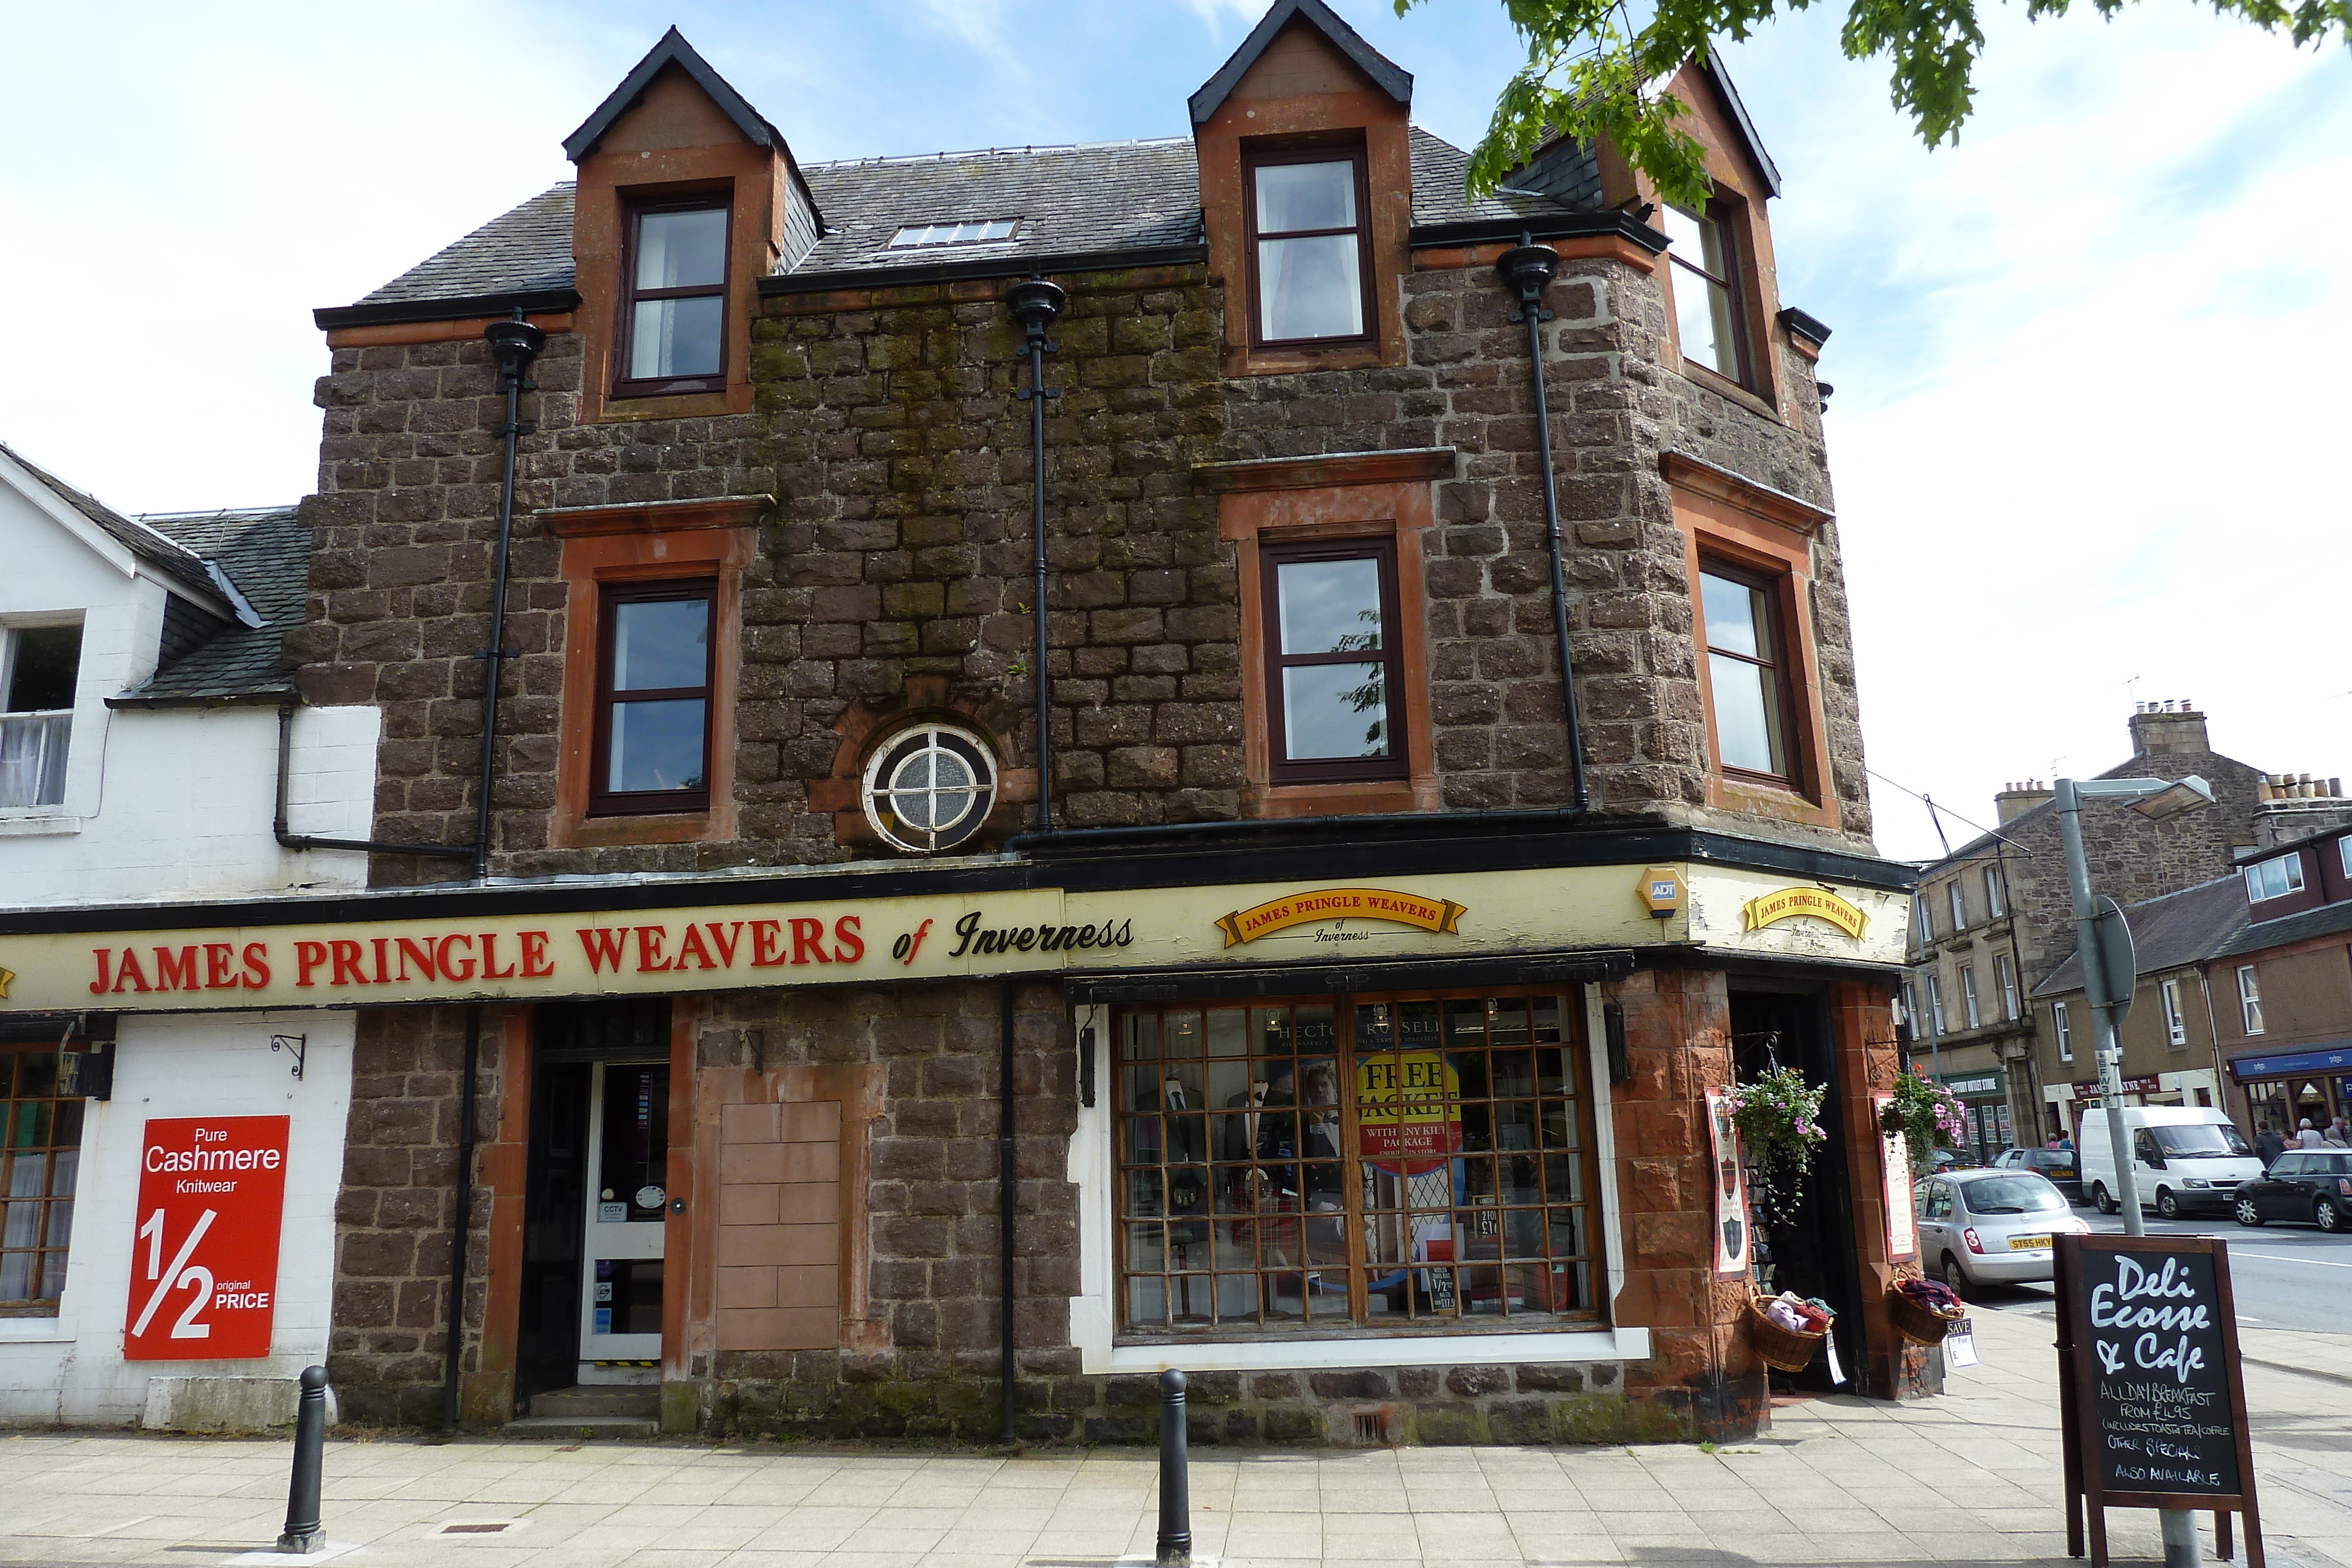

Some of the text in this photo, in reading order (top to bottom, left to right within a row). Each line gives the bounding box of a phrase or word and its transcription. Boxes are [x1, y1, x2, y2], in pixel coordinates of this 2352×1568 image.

[1652, 884, 1675, 895] ADT
[1245, 896, 1436, 931] JAMES PRINGLE WEAVERS
[1760, 895, 1858, 928] JAMES PRINGLE WEAVERS
[1335, 918, 1346, 931] of
[1314, 928, 1370, 942] Inverness
[90, 911, 1134, 995] JAMES PRINGLE WEAVERS of Inverness
[195, 1128, 227, 1142] Pure
[1367, 1127, 1396, 1137] WITH
[146, 1145, 280, 1173] Cashmere
[176, 1179, 238, 1193] Knitwear
[2013, 1238, 2051, 1248] ST55 HKY
[131, 1208, 218, 1339] 1/2
[2114, 1255, 2195, 1300] Deli
[216, 1280, 250, 1291] original
[1432, 1279, 1447, 1292] 1/2
[215, 1293, 269, 1309] PRICE
[2091, 1283, 2210, 1331] Ecosse
[1949, 1321, 1970, 1335] SAVE
[2097, 1332, 2204, 1383] & Cafe
[2101, 1380, 2216, 1406] ALL DAY BREAKFAST
[2120, 1403, 2151, 1419] FROM
[2108, 1434, 2202, 1460] OTHER SPECIALS
[2116, 1464, 2220, 1486] ALSO AVAILABLE
